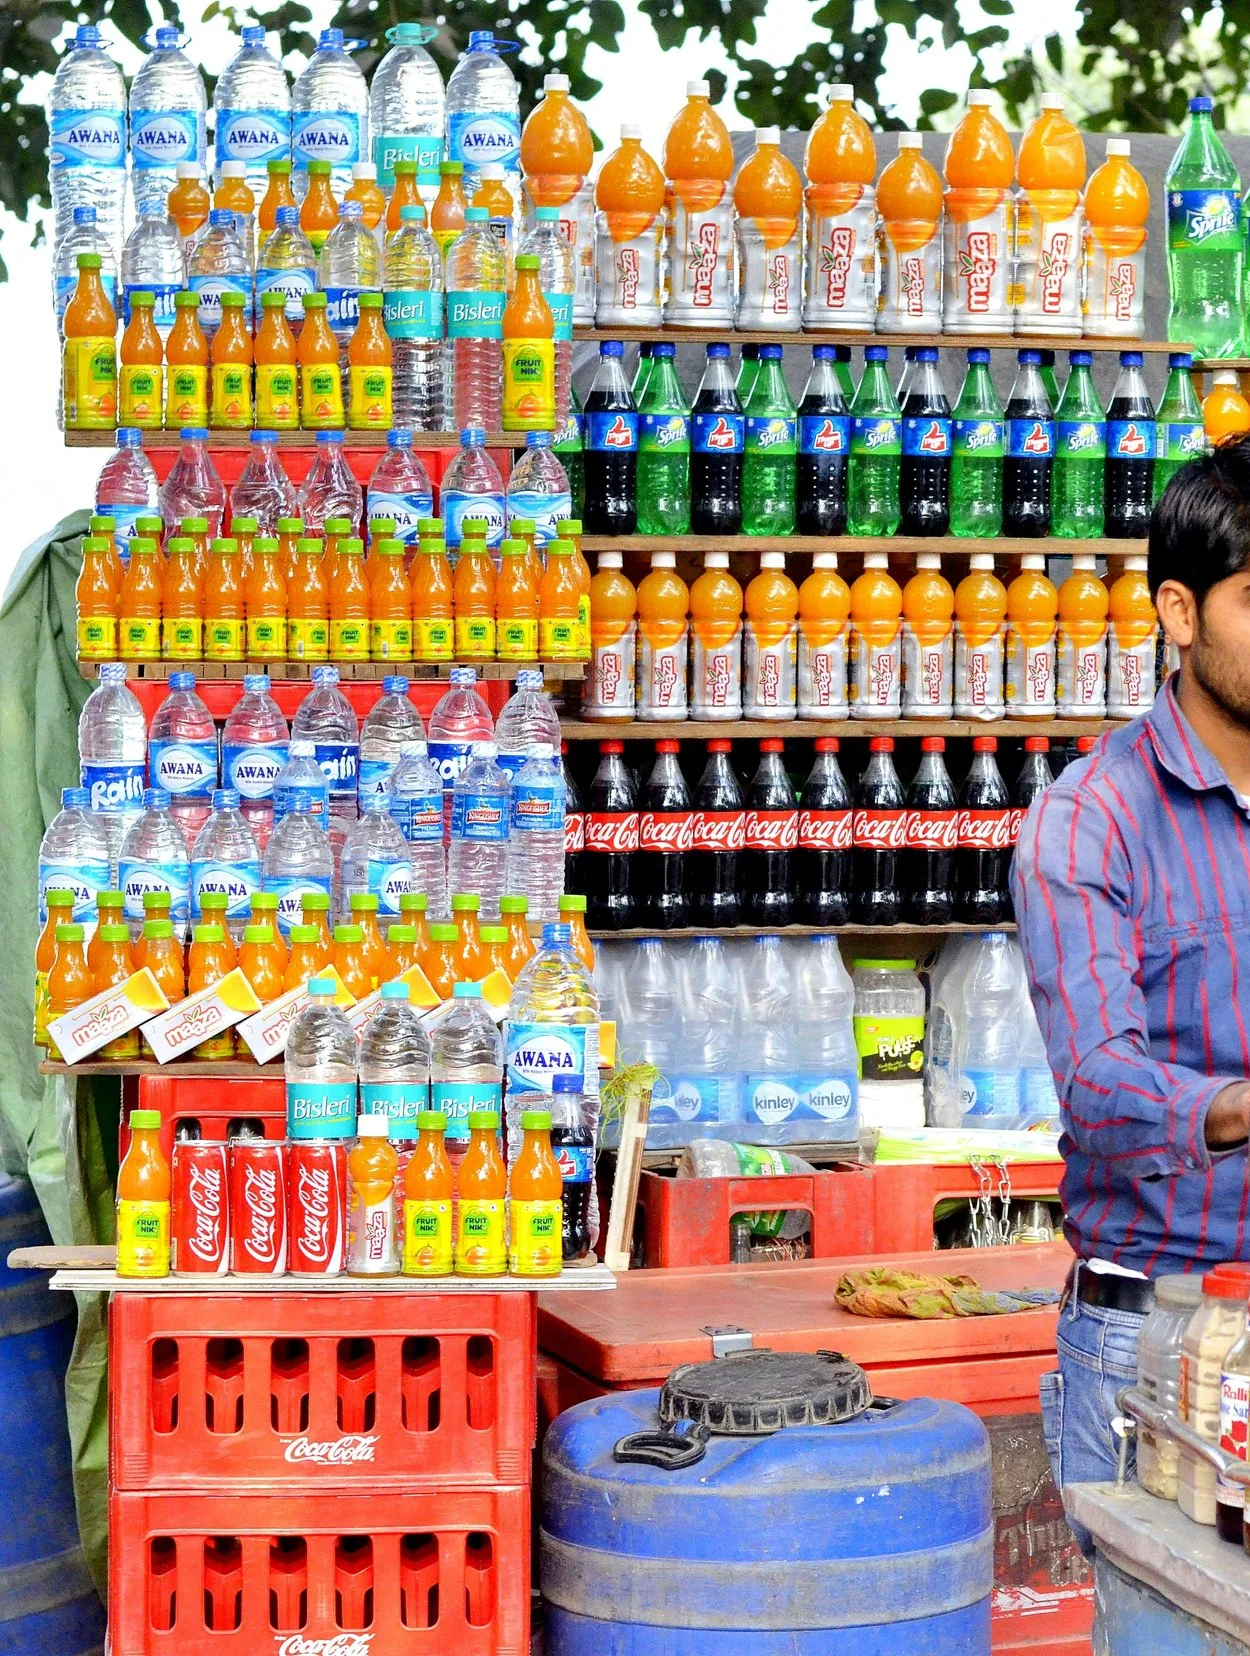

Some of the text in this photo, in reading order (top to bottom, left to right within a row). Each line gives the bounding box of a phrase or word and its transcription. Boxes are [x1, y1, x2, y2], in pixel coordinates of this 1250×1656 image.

[68, 129, 120, 144] AWANA
[136, 130, 187, 145] AWANA
[228, 130, 280, 144] AWANA
[299, 131, 349, 146] AWANA
[463, 134, 514, 148] AWANA
[383, 144, 441, 169] Bisleri
[1189, 211, 1235, 239] Sprite
[693, 222, 718, 307] maaza
[827, 227, 852, 308] maaza
[967, 232, 996, 313] maaza
[1042, 233, 1069, 313] maaza
[621, 249, 637, 309] maaza
[774, 255, 789, 314] maaza
[908, 258, 924, 317] maaza
[1116, 263, 1134, 321] maaza
[328, 290, 359, 320] ain
[453, 301, 502, 322] Bisleri
[515, 359, 541, 367] FRUIT
[520, 367, 538, 375] NIK
[656, 426, 688, 445] Sprite
[758, 426, 790, 446] Sprite
[866, 427, 898, 447] Sprite
[967, 431, 998, 450] Sprite
[1068, 433, 1101, 451] Sprite
[602, 653, 620, 704] maaza
[659, 655, 677, 706] maaza
[713, 655, 731, 706] maaza
[763, 655, 778, 706] maaza
[816, 654, 831, 705] maaza
[877, 653, 893, 705] maaza
[973, 653, 988, 705] maaza
[1034, 652, 1050, 702] maaza
[160, 762, 203, 776] AWANA
[236, 767, 281, 779] AWANA
[320, 747, 356, 780] ain
[199, 884, 248, 896] AWANA
[72, 1005, 129, 1046] maaza
[165, 1005, 222, 1047] maaza
[514, 1051, 573, 1068] AWANA
[879, 1035, 916, 1060] PULSE
[294, 1095, 350, 1119] Bisleri
[371, 1096, 425, 1119] Bisleri
[440, 1095, 496, 1118] Bisleri
[755, 1095, 795, 1111] kinley
[809, 1093, 850, 1109] kinley
[189, 1163, 220, 1262] Coca-Cola
[244, 1163, 276, 1262] Coca-Cola
[298, 1163, 329, 1262] Coca-Cola
[370, 1211, 387, 1259] maaza
[1223, 1383, 1249, 1401] Ralli
[284, 1435, 380, 1463] Coca-Cola
